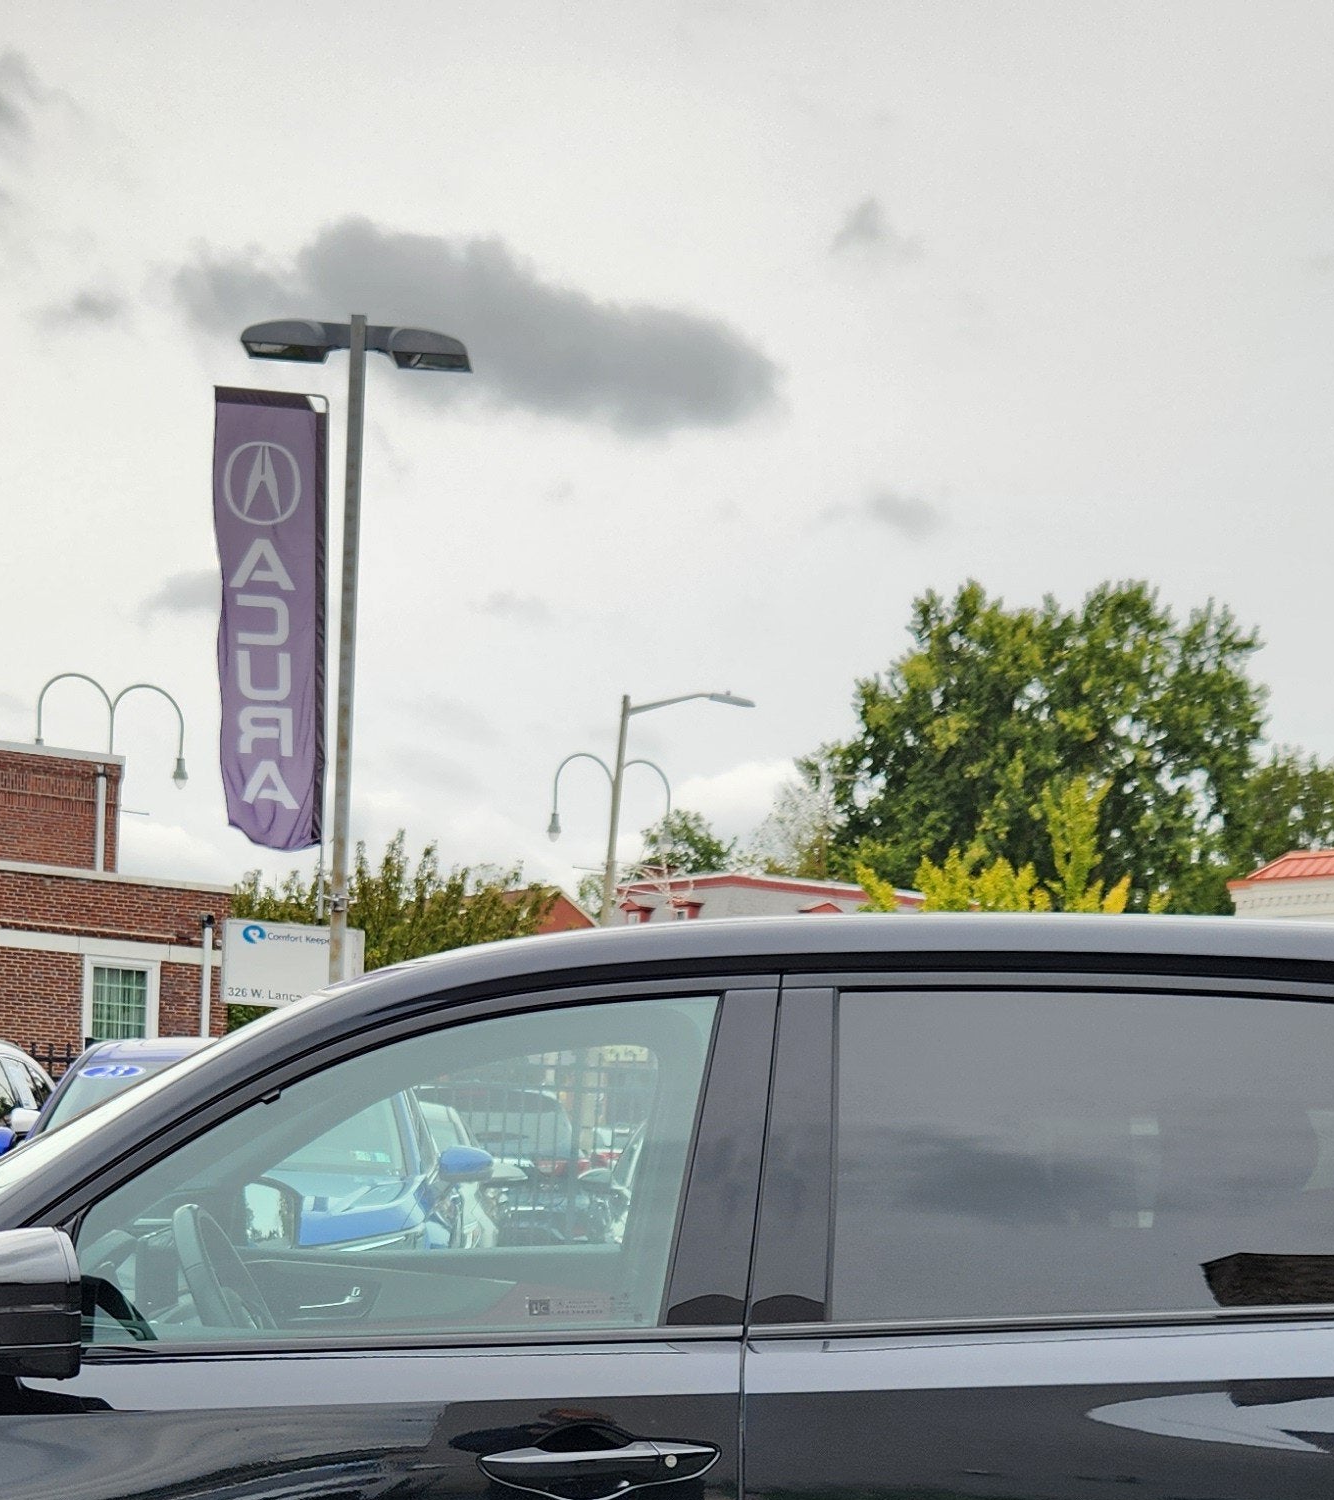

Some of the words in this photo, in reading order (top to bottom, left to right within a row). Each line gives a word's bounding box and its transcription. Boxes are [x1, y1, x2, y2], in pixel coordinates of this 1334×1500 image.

[267, 932, 302, 943] Comfort
[228, 987, 247, 998] 326
[251, 989, 264, 999] W.
